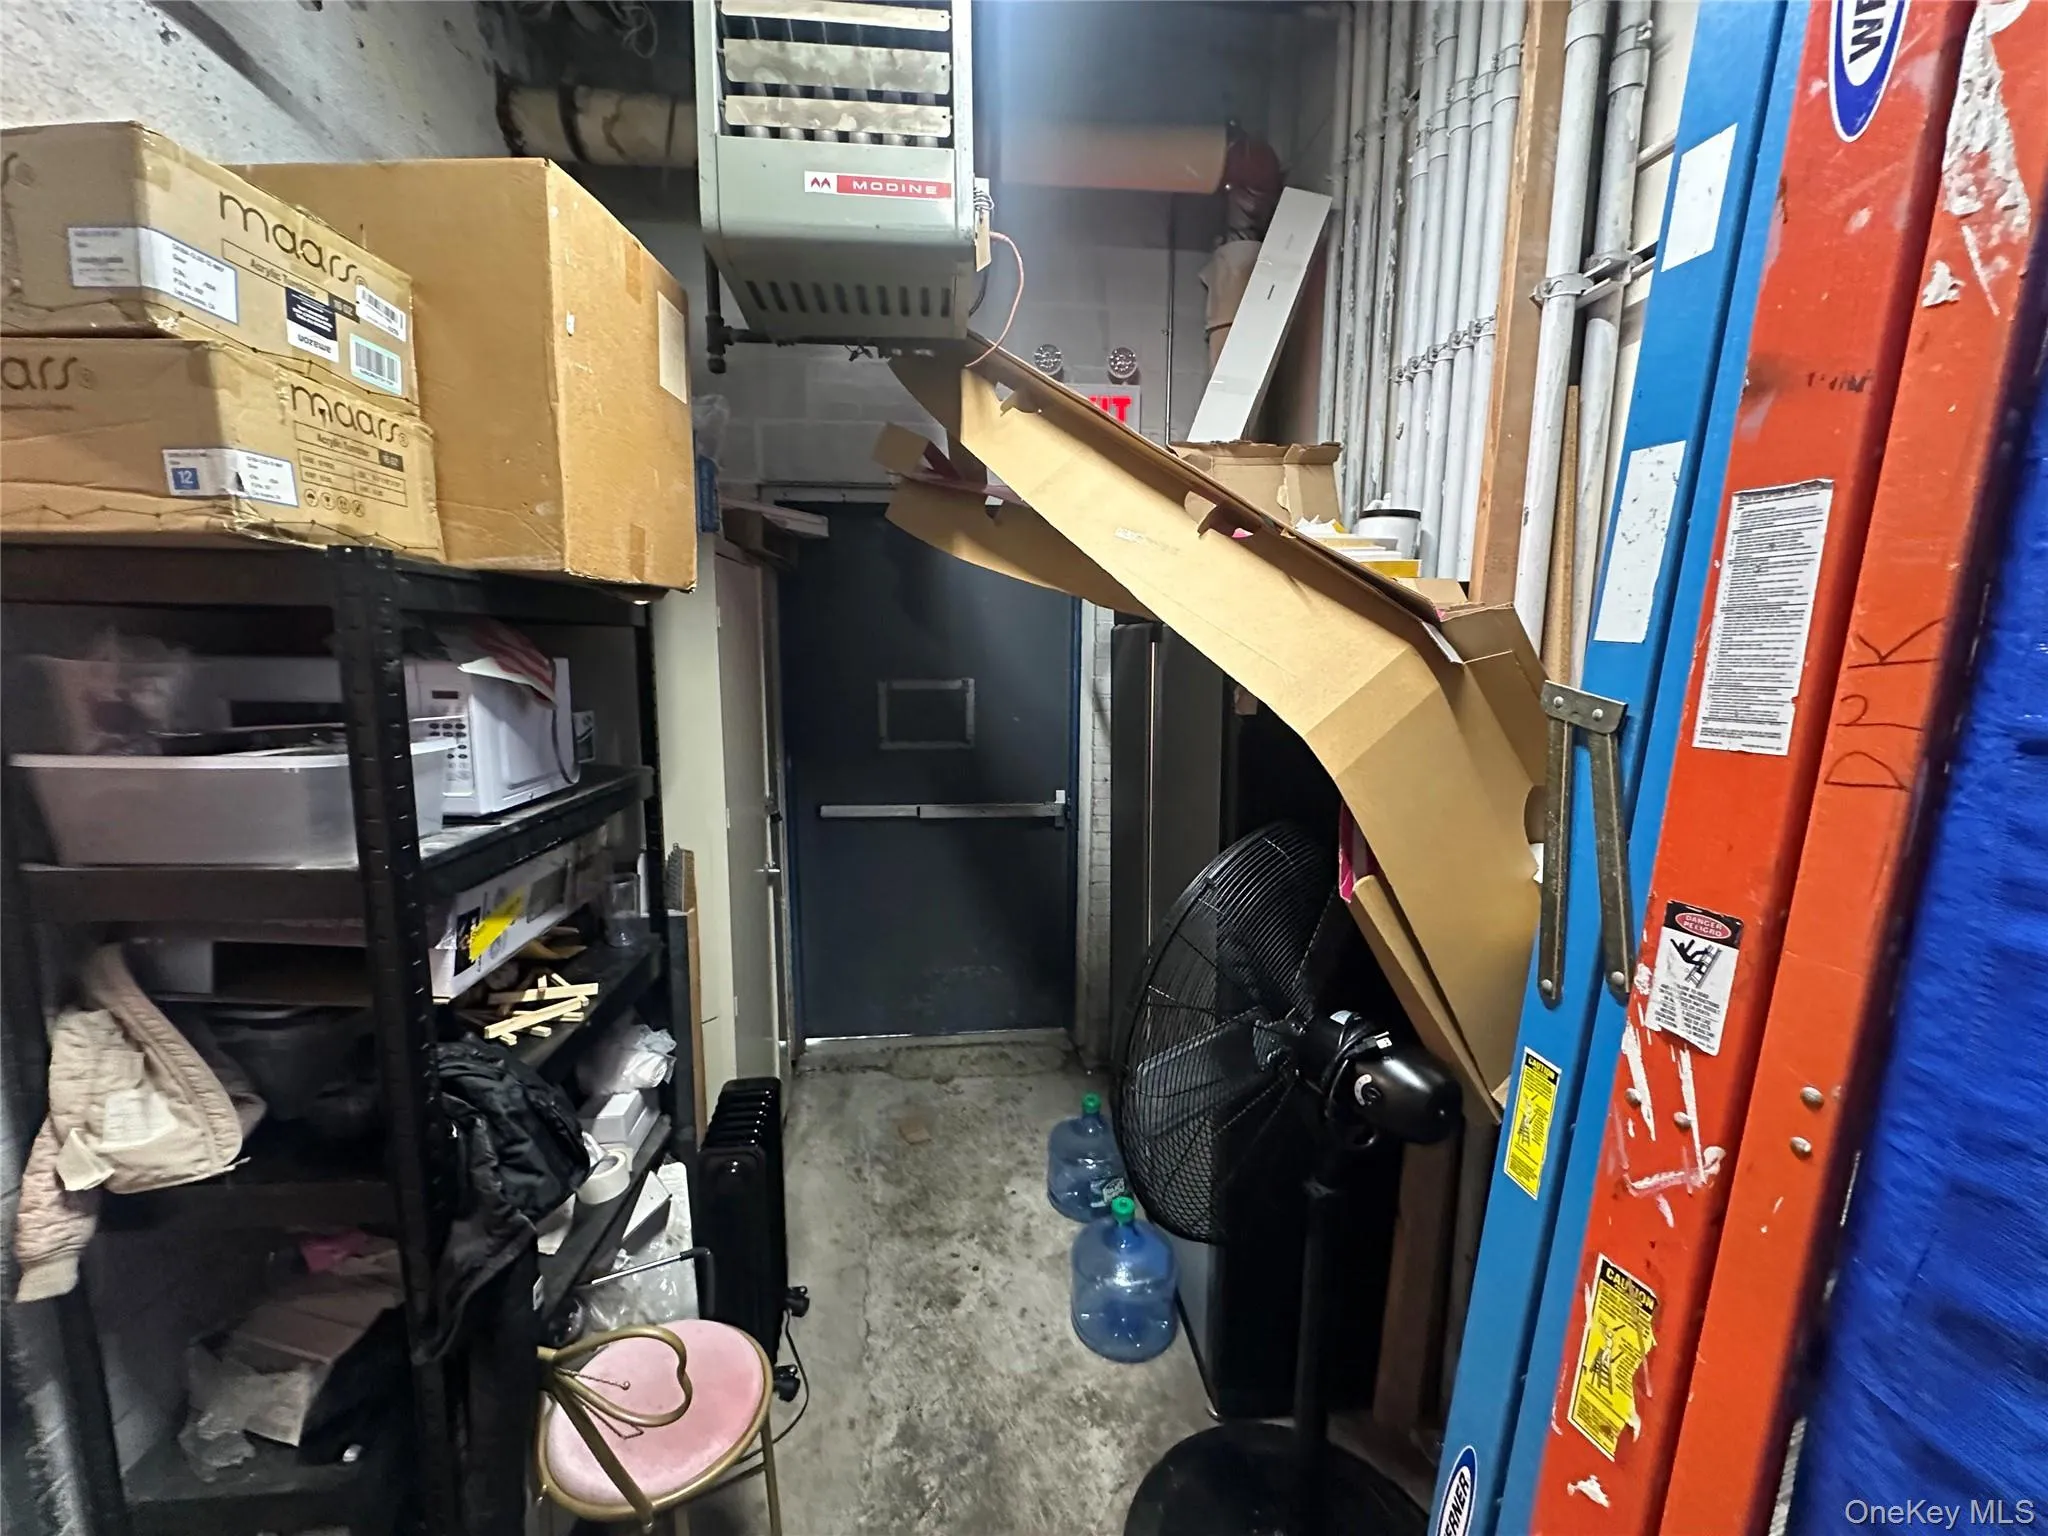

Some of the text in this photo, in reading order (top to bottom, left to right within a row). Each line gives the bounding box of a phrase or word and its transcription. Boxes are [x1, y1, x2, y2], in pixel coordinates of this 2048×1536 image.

[852, 181, 938, 195] MODINE
[219, 191, 358, 283] maars
[297, 333, 332, 354] amazon
[0, 356, 78, 390] ars
[290, 384, 400, 443] maars
[178, 470, 194, 485] 12
[1683, 920, 1723, 938] PELIGRO
[1684, 915, 1723, 930] DANGER
[1528, 1055, 1556, 1080] CAUTION
[1444, 1471, 1470, 1536] ERNER
